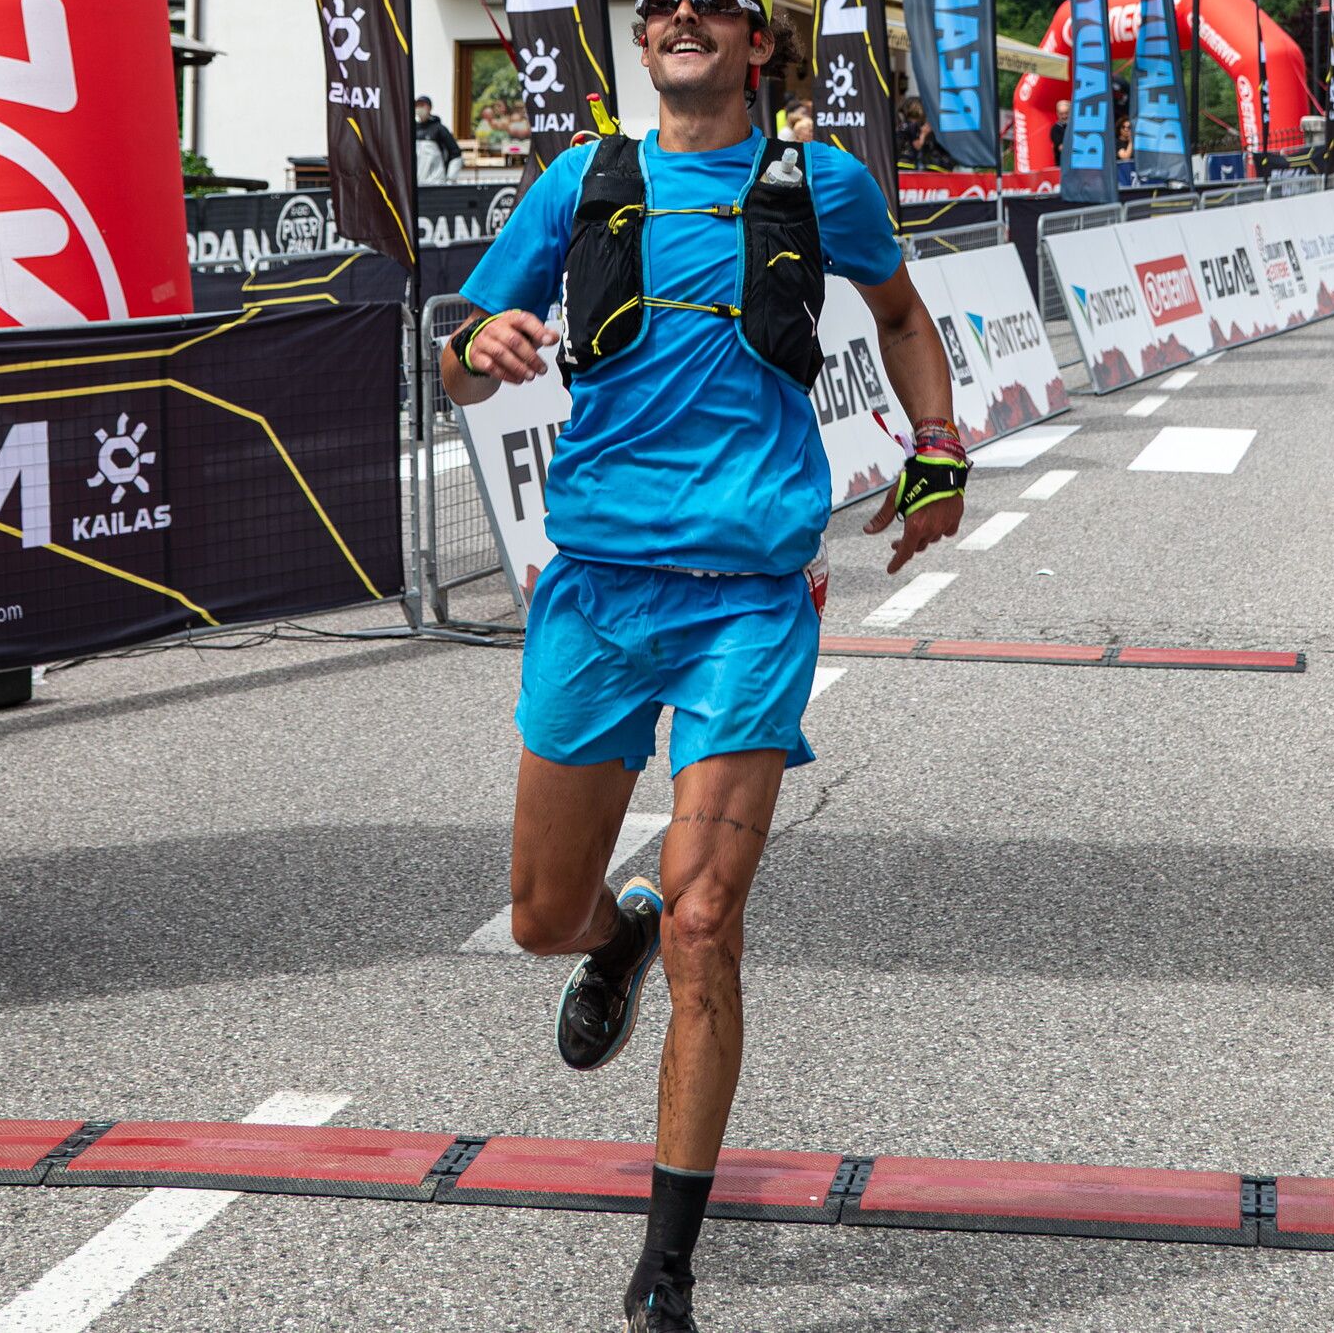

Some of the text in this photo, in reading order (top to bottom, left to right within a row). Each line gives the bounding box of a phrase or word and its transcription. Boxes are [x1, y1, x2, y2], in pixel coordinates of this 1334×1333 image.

[987, 309, 1041, 359] SINTECO
[905, 477, 929, 504] LEKI
[72, 504, 172, 542] KAILAS
